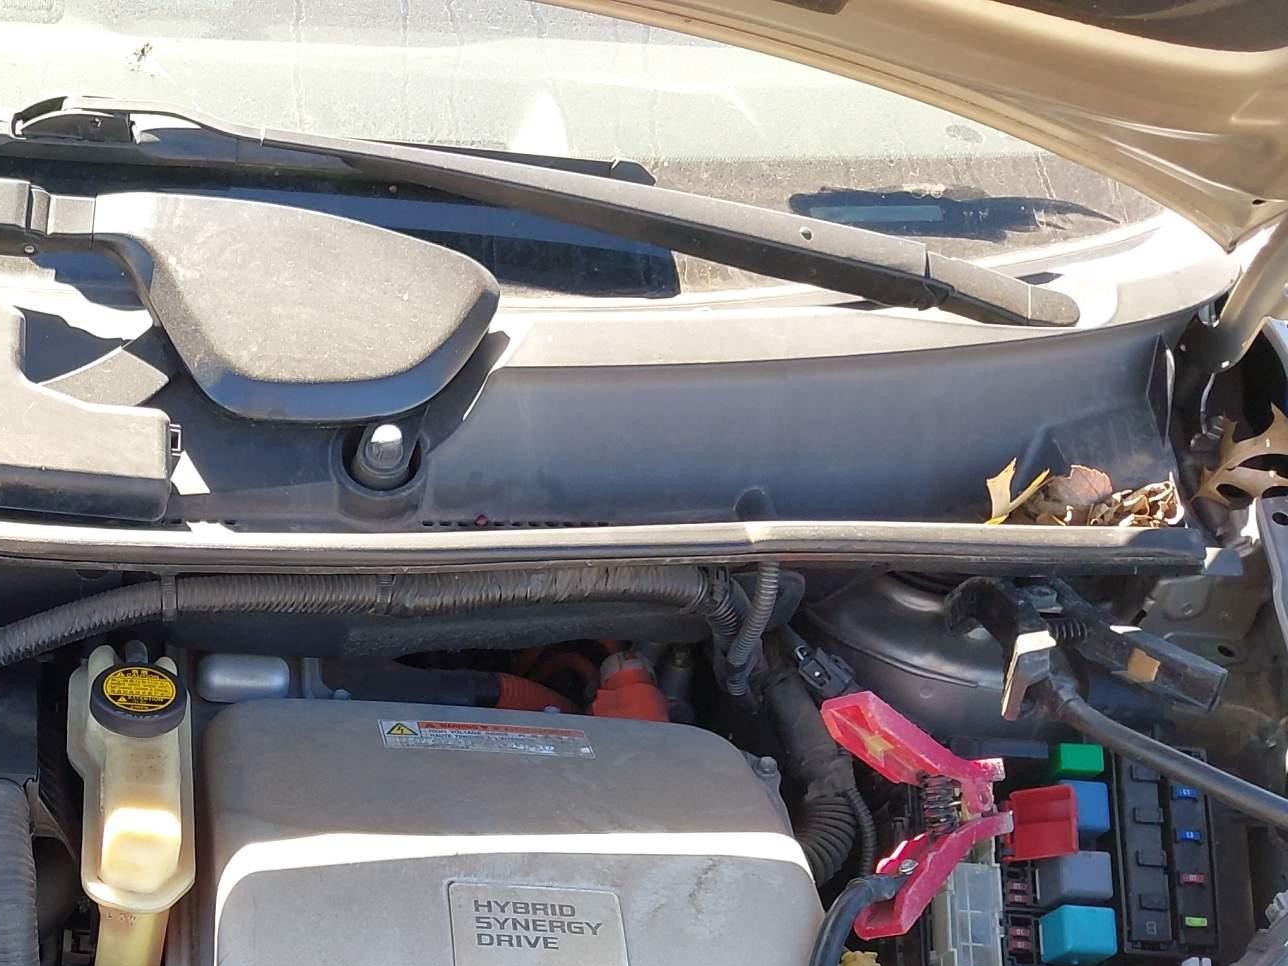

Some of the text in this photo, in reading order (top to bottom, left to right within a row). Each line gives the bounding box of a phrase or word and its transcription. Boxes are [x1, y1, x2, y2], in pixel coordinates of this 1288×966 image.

[473, 899, 576, 918] HYBRID
[475, 915, 603, 936] SYNERGY
[476, 932, 560, 950] DRIVE
